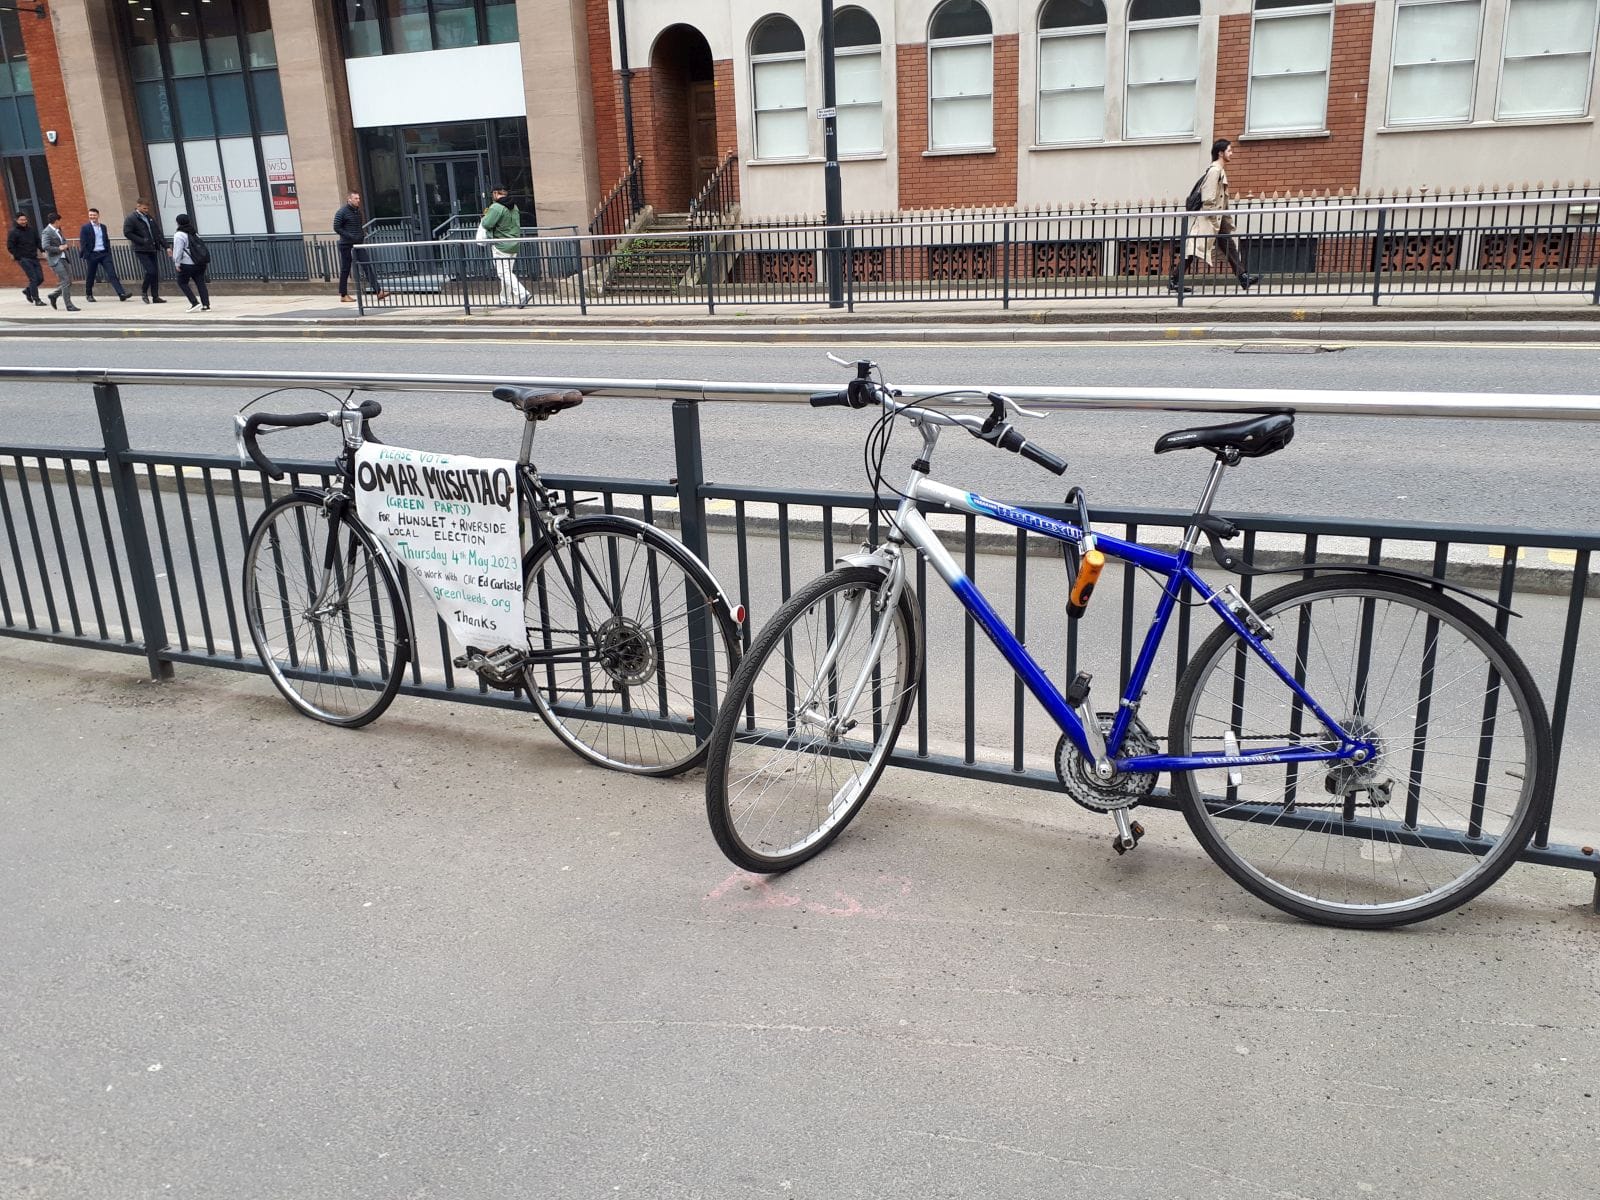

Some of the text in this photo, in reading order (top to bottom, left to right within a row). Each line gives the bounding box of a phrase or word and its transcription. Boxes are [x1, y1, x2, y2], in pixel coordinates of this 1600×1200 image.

[157, 169, 183, 208] 76
[191, 175, 222, 184] GRADE A
[192, 183, 222, 192] OFFICES
[227, 178, 260, 189] TO LET
[379, 448, 412, 461] PLEASE
[357, 460, 512, 513] OMAR MUSHTAQ
[386, 494, 471, 516] (GREEN PARTY)
[398, 512, 446, 529] HUNSLET
[459, 519, 507, 534] RIVERSIDE
[388, 527, 486, 545] LOCAL ELECTION
[397, 541, 448, 566] Thursday
[468, 549, 489, 574] May
[490, 554, 518, 570] 2023
[424, 570, 443, 579] work
[478, 575, 489, 588] Ed
[490, 578, 522, 592] Carlisle
[454, 609, 497, 631] Thanks
